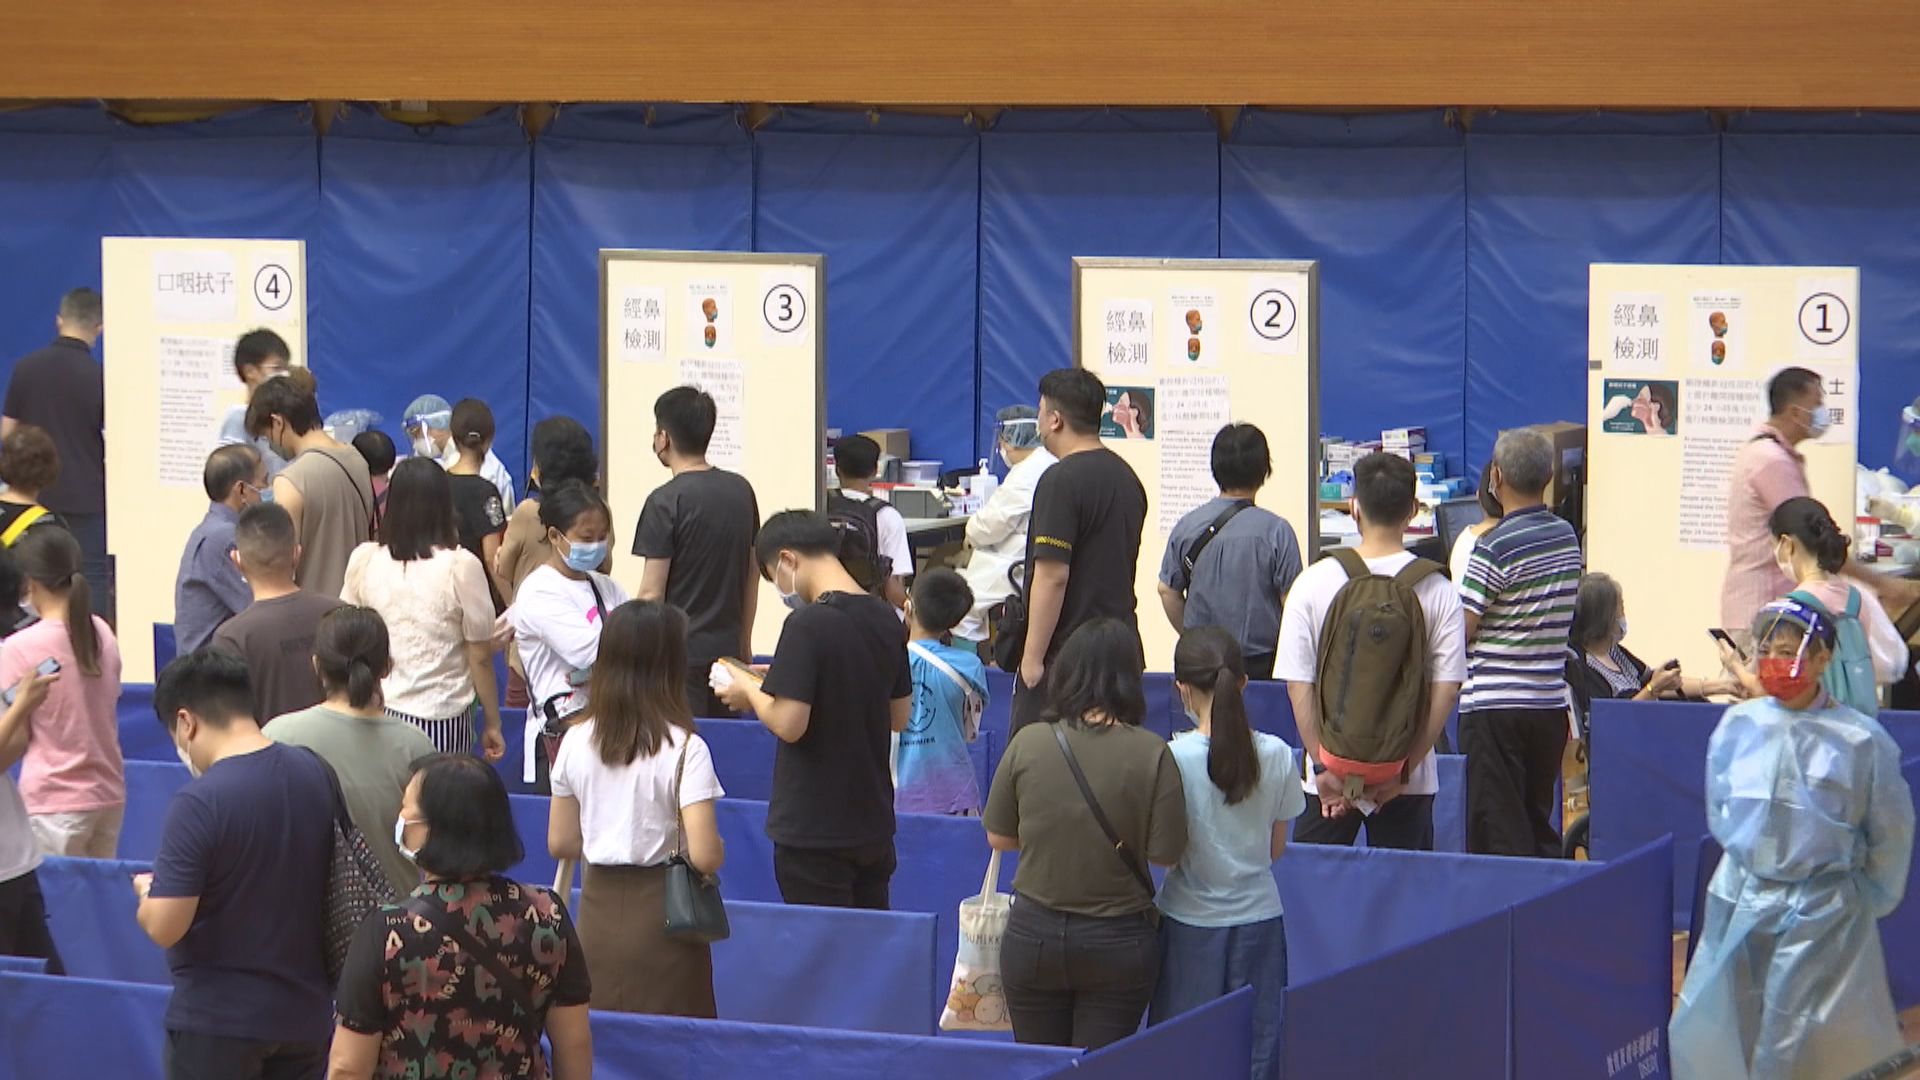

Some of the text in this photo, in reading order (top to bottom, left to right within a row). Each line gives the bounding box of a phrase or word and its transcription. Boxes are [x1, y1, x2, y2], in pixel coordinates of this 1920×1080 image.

[157, 271, 234, 294] 口咽拭子
[265, 273, 281, 299] 4
[623, 297, 661, 319] 經鼻
[778, 293, 793, 322] 3
[1264, 299, 1282, 328] 2
[1613, 303, 1660, 328] 經鼻
[1815, 303, 1833, 333] 1
[1106, 309, 1147, 333] 經鼻
[623, 328, 661, 351] 檢測
[1613, 337, 1660, 361] 檢測
[1106, 342, 1149, 365] 檢測
[438, 964, 466, 1000] love
